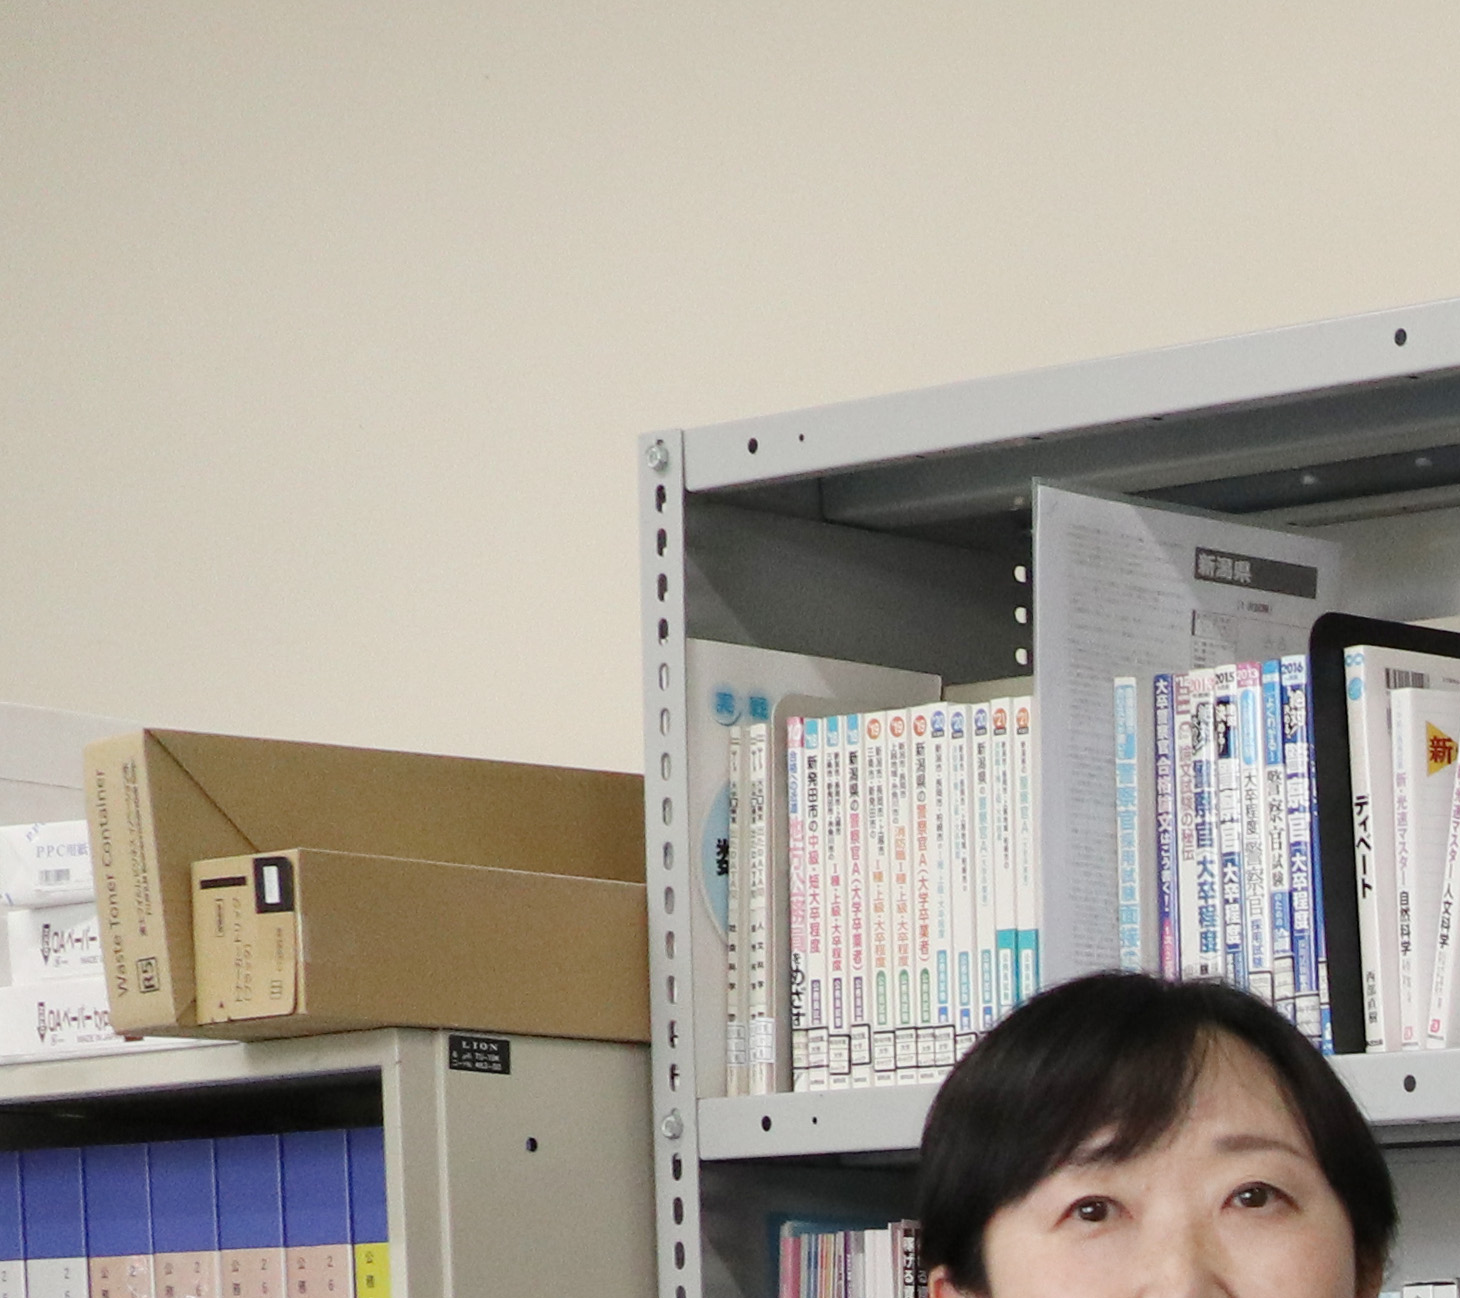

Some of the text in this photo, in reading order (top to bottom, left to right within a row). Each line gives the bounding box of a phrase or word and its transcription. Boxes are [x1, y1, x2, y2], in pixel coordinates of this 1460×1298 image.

[1429, 736, 1453, 765] 新
[1354, 795, 1373, 898] ディベート
[96, 769, 129, 997] Waste Toner Container
[1438, 882, 1455, 948] 人文科学
[1399, 890, 1412, 956] 自然科学
[140, 960, 157, 992] R5
[462, 1041, 499, 1051] LION
